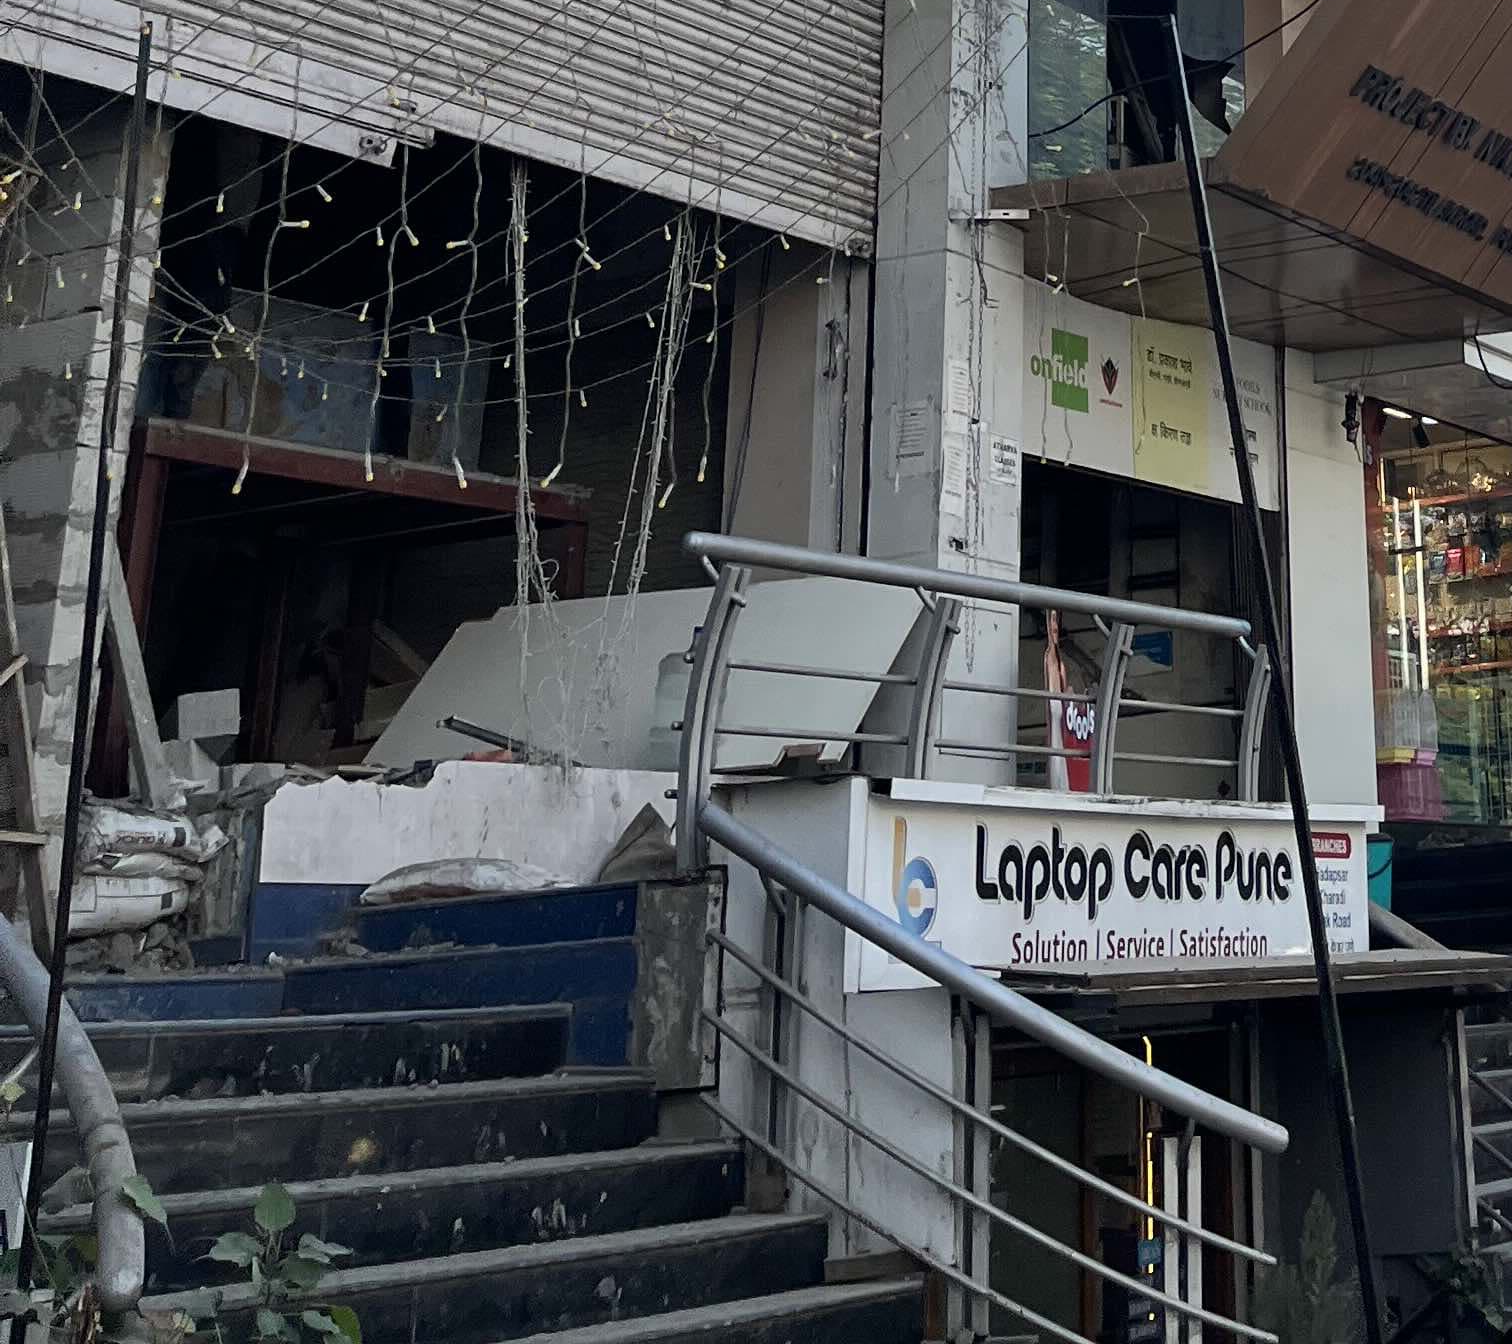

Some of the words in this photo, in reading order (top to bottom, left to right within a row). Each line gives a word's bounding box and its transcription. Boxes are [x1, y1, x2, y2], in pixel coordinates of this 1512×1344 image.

[974, 823, 1115, 923] Laptop
[1124, 829, 1209, 904] Care
[1215, 829, 1295, 904] Pune
[1315, 866, 1349, 885] adapsar
[1332, 912, 1352, 929] Road
[1011, 931, 1089, 965] Solution
[1105, 930, 1166, 961] Service
[1179, 927, 1269, 959] Satisfaction
